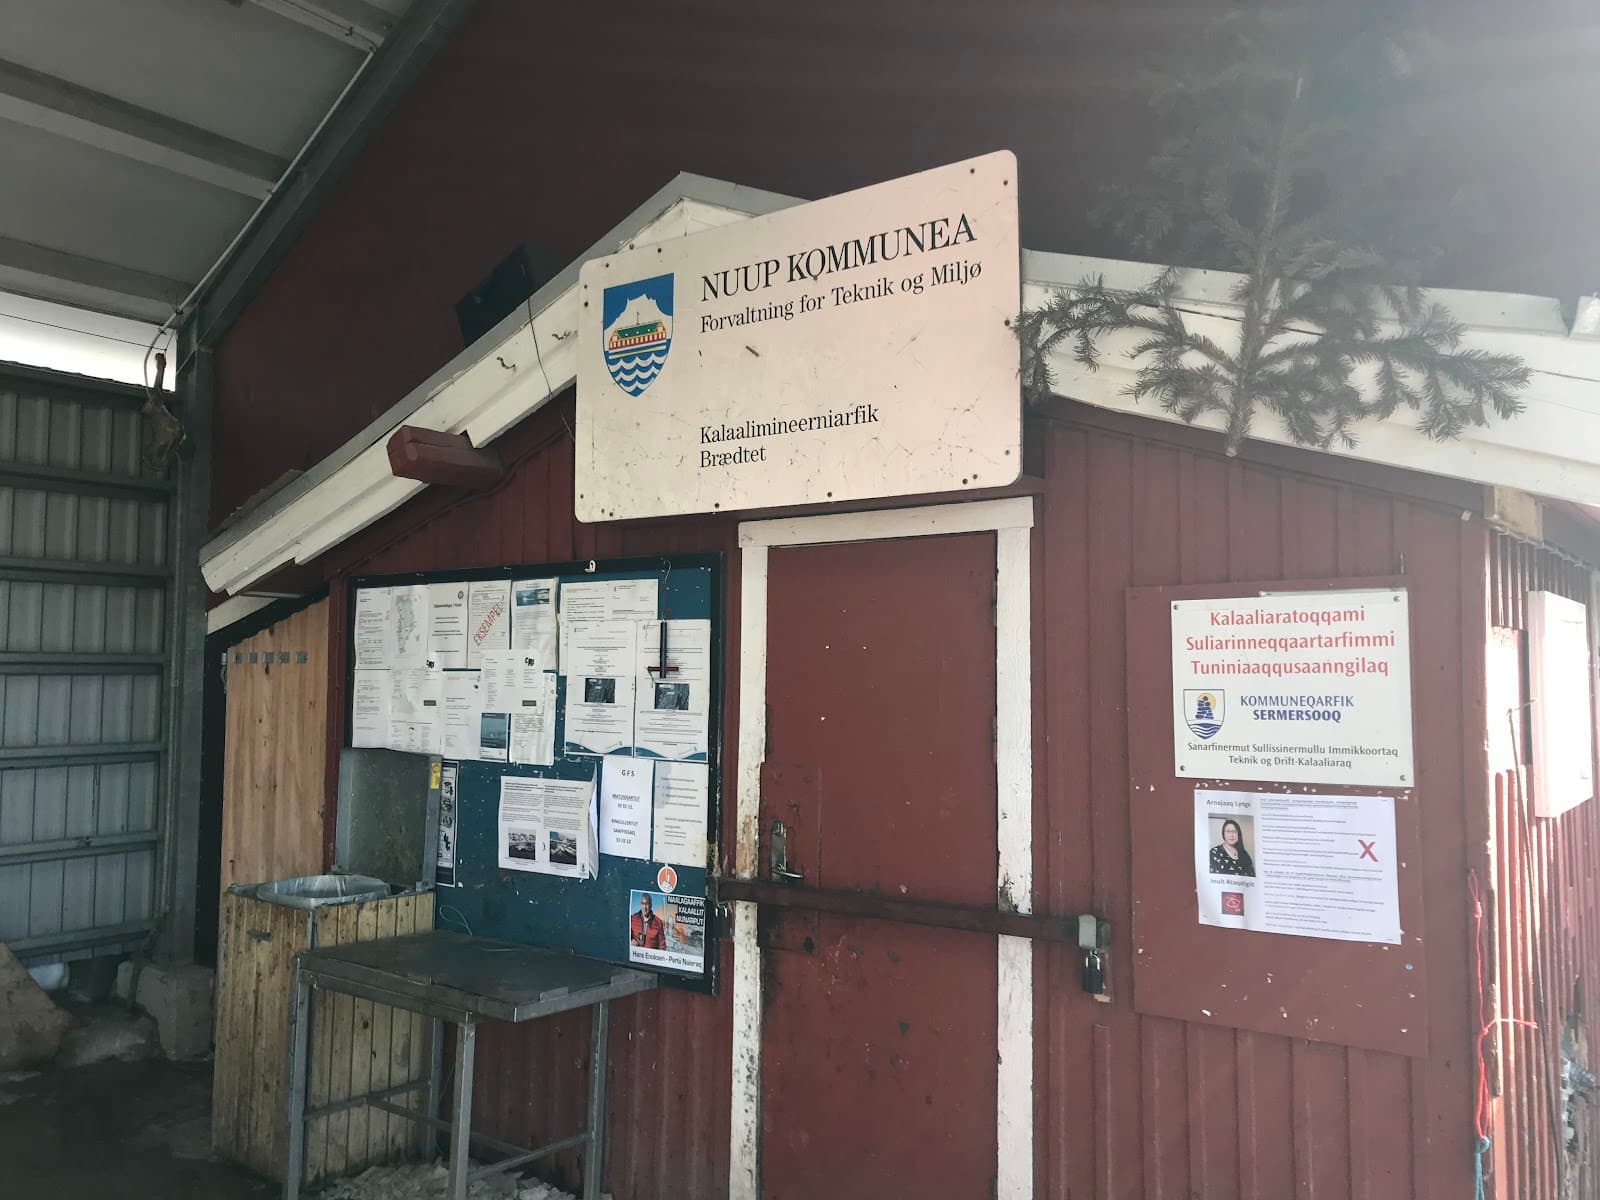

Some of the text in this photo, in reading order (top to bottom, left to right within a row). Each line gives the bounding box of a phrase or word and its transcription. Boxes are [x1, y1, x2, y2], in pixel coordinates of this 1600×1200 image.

[701, 213, 978, 302] NUUP KOMMUNEA
[700, 260, 983, 333] Forvaltning for Teknik og Miljø
[700, 404, 880, 444] Kalaalimineerniarfik
[700, 444, 767, 468] Brædtet
[1210, 606, 1365, 626] Kalaaliaratoqqami
[1186, 630, 1395, 652] Suliarinneqqaartarfimmi
[1191, 657, 1389, 677] Tuniniaaqqusaanngilaq
[1240, 695, 1354, 708] KOMMUNEQARFIK
[1253, 709, 1341, 723] SERMERSOOQ
[1188, 742, 1399, 757] Sanarfinermut Sullissinermullu Immikkoortaq
[1229, 755, 1258, 764] Teknik
[1260, 758, 1272, 766] og
